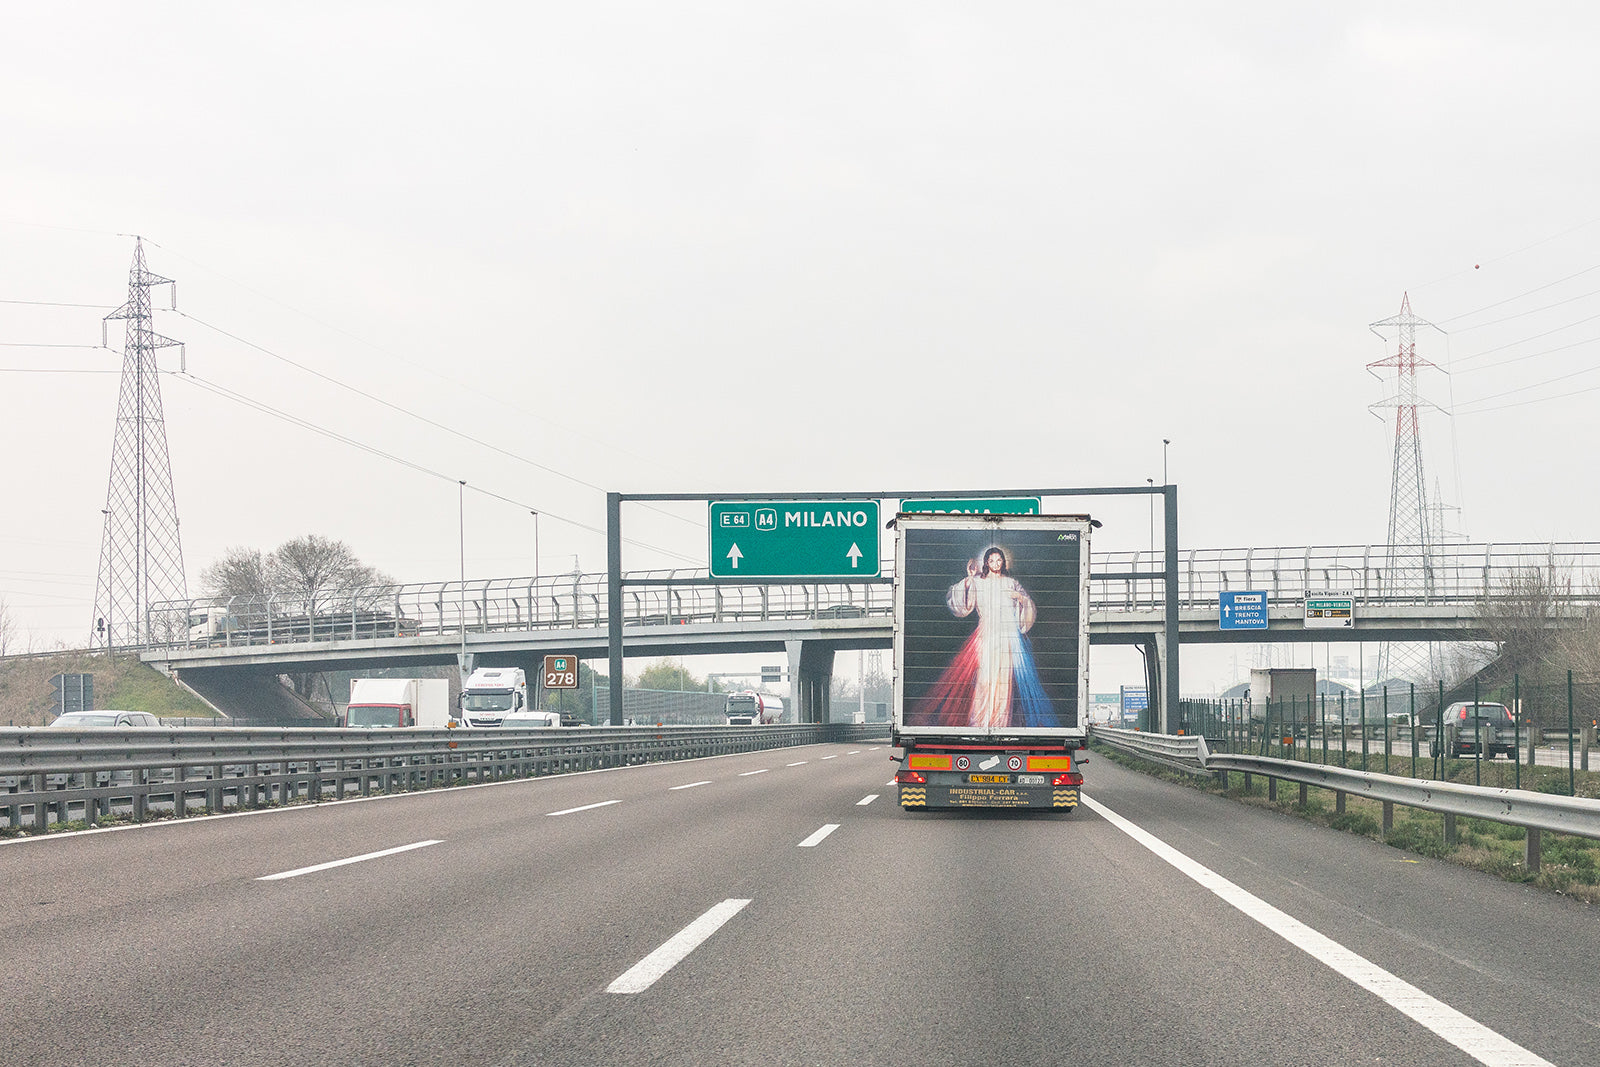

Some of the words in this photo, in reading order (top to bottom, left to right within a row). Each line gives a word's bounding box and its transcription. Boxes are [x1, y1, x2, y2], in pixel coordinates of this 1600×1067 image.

[723, 515, 730, 525] E
[733, 515, 745, 525] 64
[759, 513, 774, 526] A4
[785, 511, 868, 527] MILANO
[556, 661, 565, 669] A4
[547, 672, 574, 685] 278
[958, 759, 968, 767] 80
[1010, 759, 1019, 767] 70
